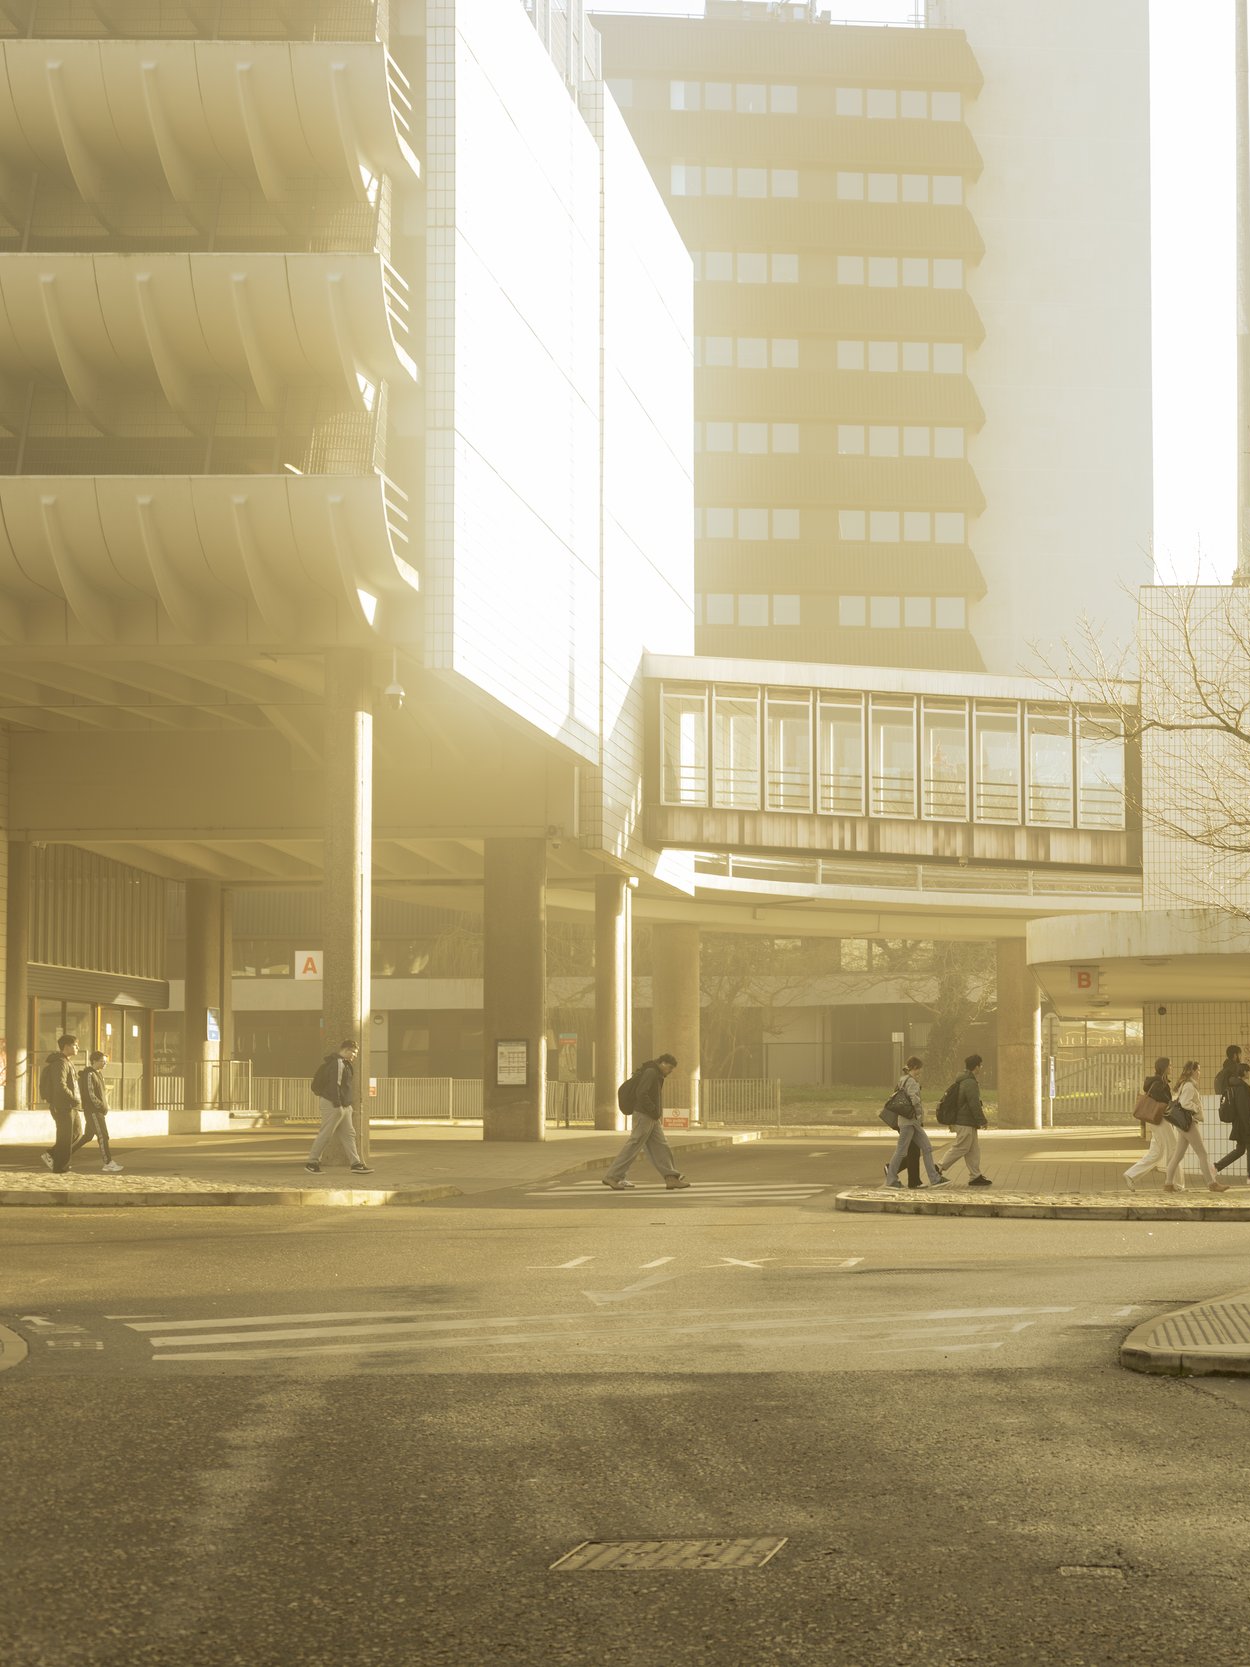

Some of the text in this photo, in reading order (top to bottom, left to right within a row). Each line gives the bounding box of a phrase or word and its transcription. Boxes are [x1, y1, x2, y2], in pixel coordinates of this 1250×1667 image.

[302, 957, 317, 974] A
[1077, 972, 1091, 988] B
[525, 1256, 865, 1270] EXIT
